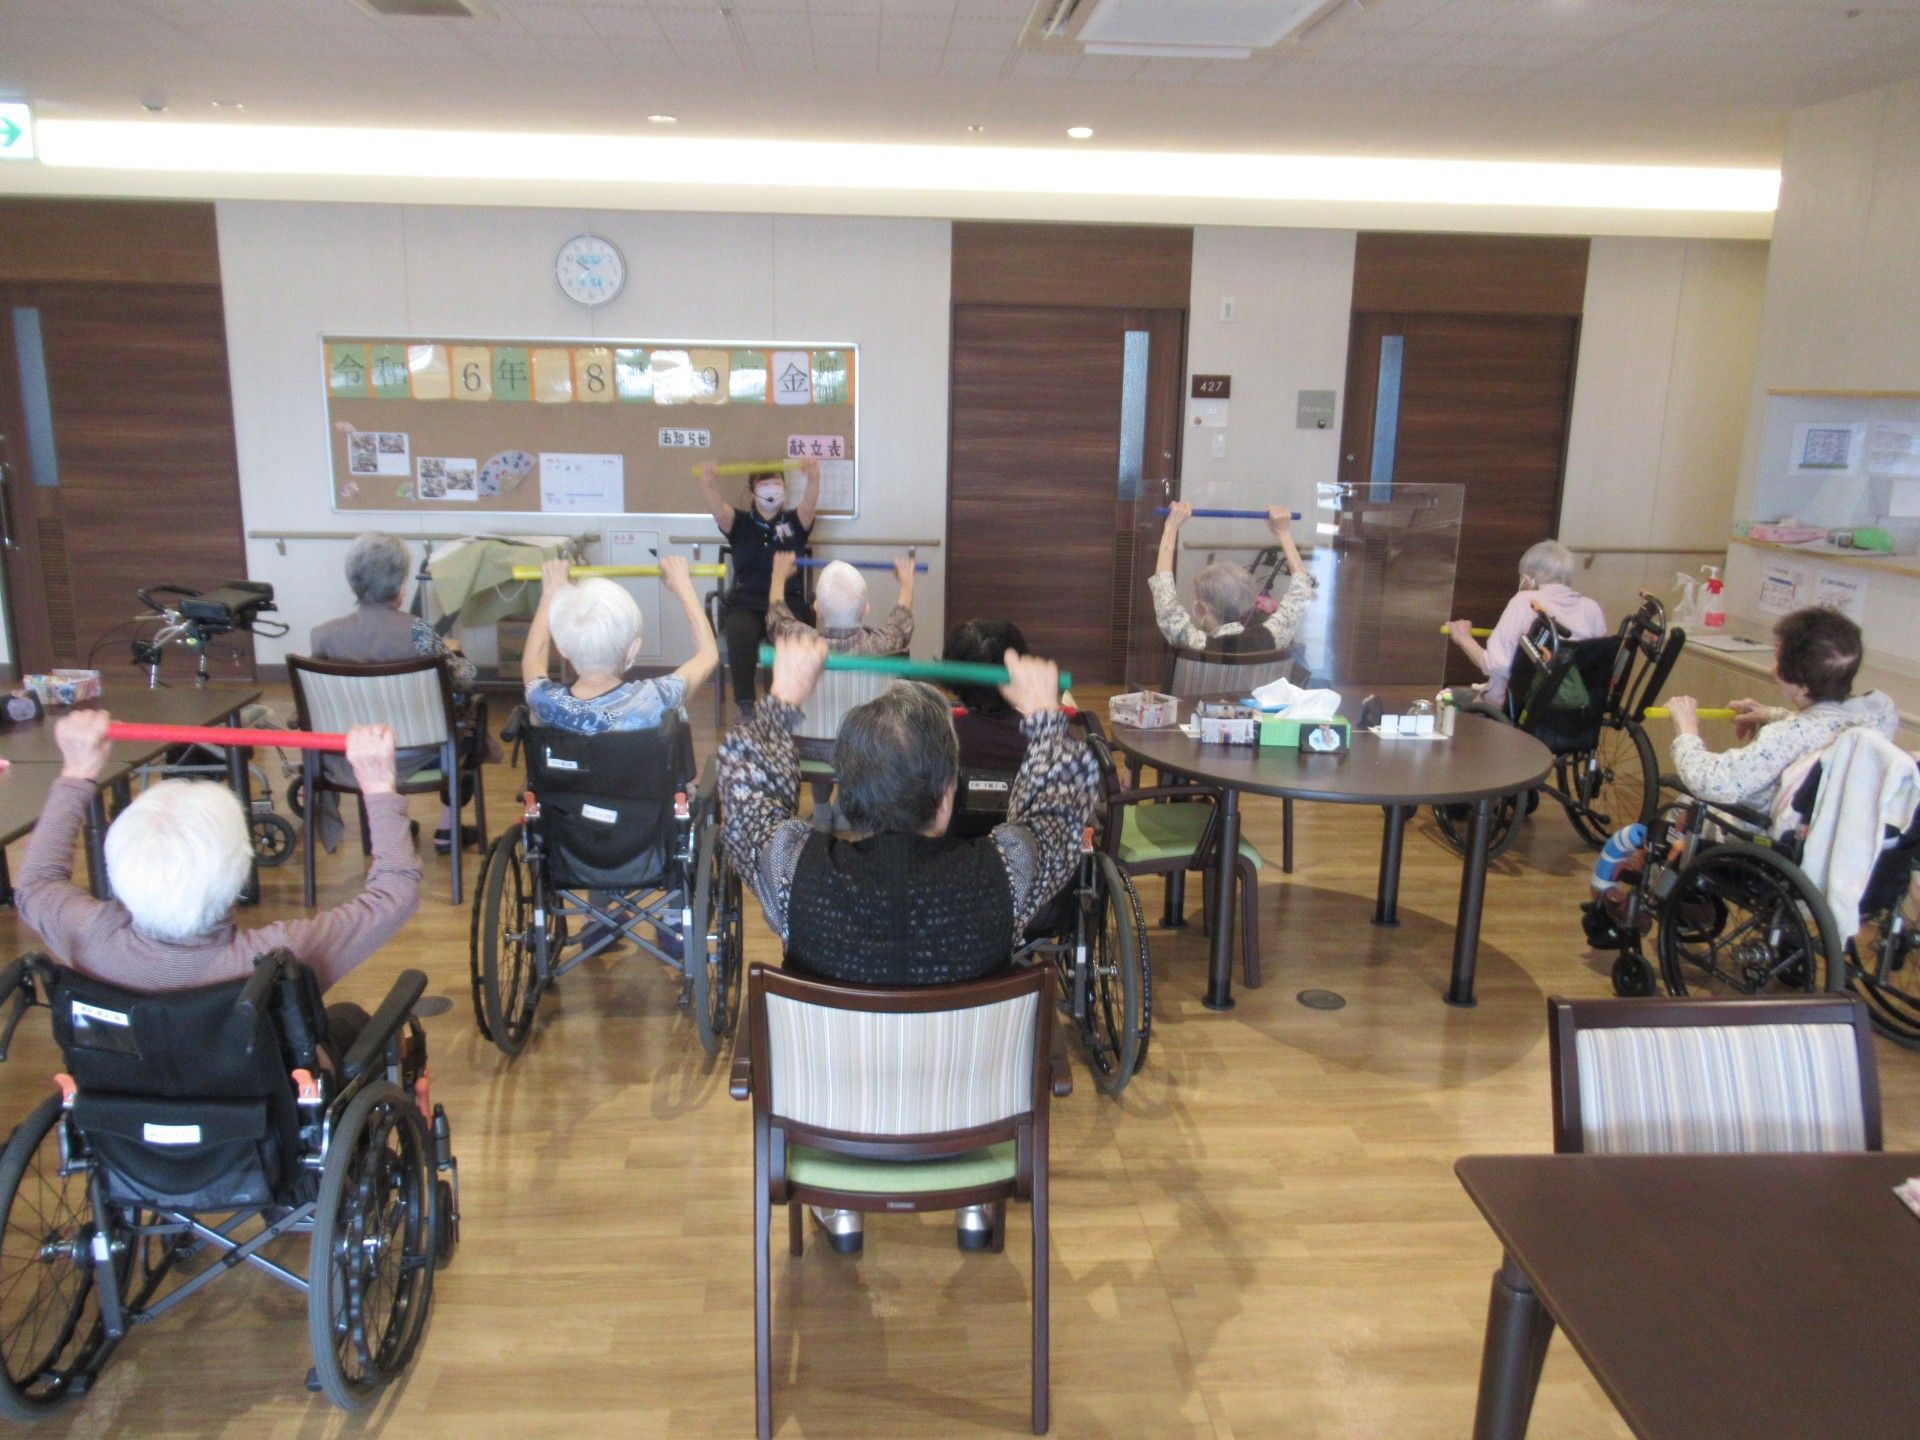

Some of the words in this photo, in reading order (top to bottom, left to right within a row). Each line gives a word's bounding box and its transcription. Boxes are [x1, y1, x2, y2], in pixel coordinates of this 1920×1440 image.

[1200, 381, 1223, 392] 427
[662, 429, 707, 446] お知らせ
[788, 438, 841, 457] 献立表
